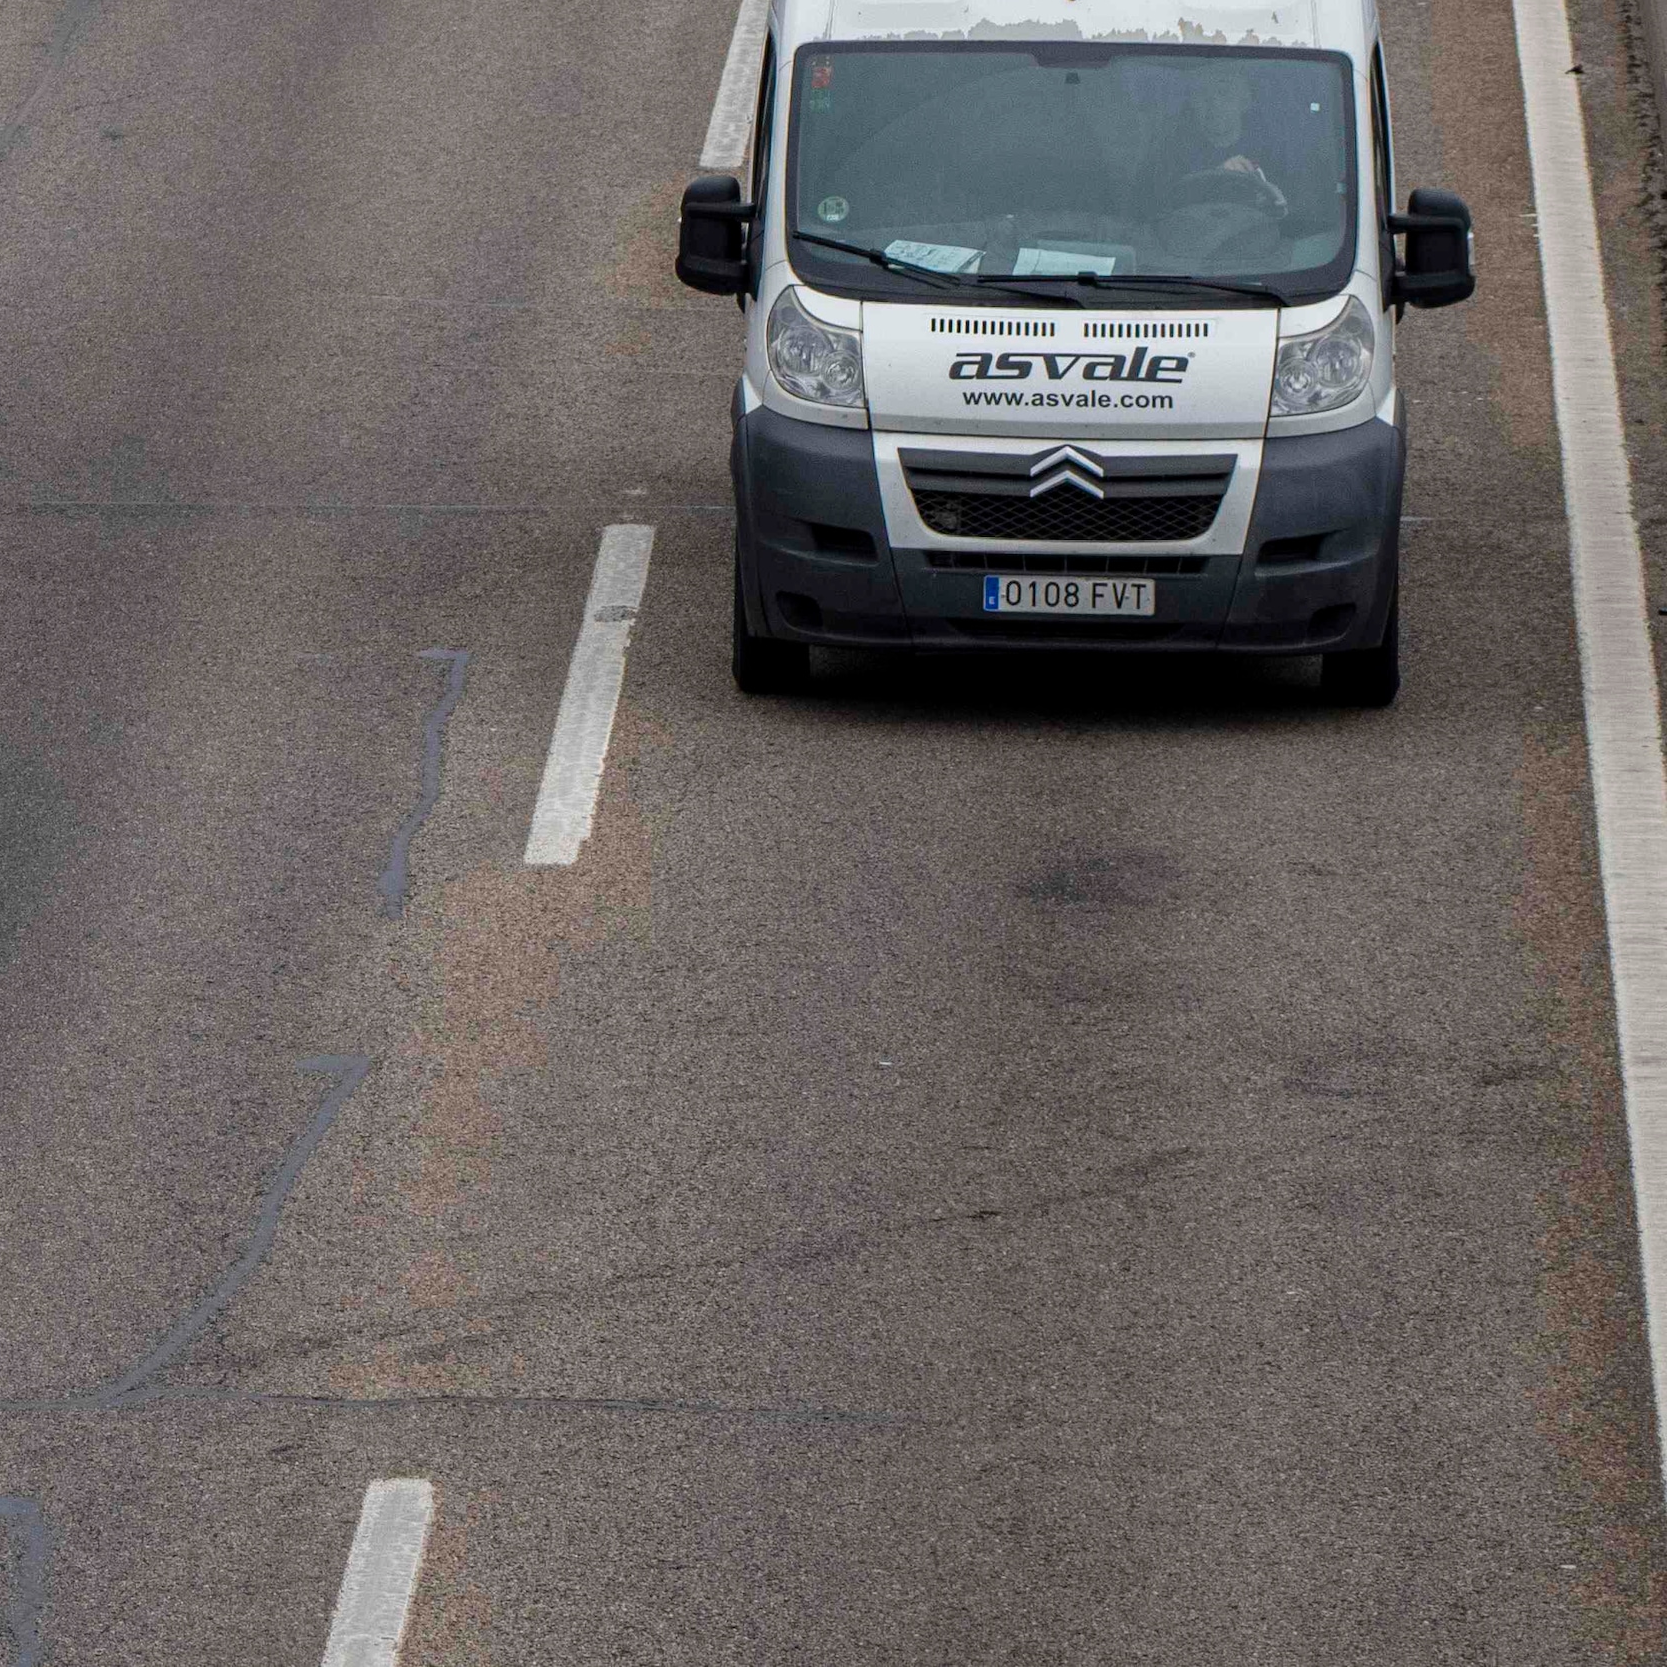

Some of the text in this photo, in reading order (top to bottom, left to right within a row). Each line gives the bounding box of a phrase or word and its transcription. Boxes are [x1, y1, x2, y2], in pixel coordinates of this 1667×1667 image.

[948, 345, 1189, 384] asvale
[962, 389, 1174, 409] www.asvale.com
[1005, 580, 1080, 608] 0108
[1091, 582, 1147, 610] FVT
